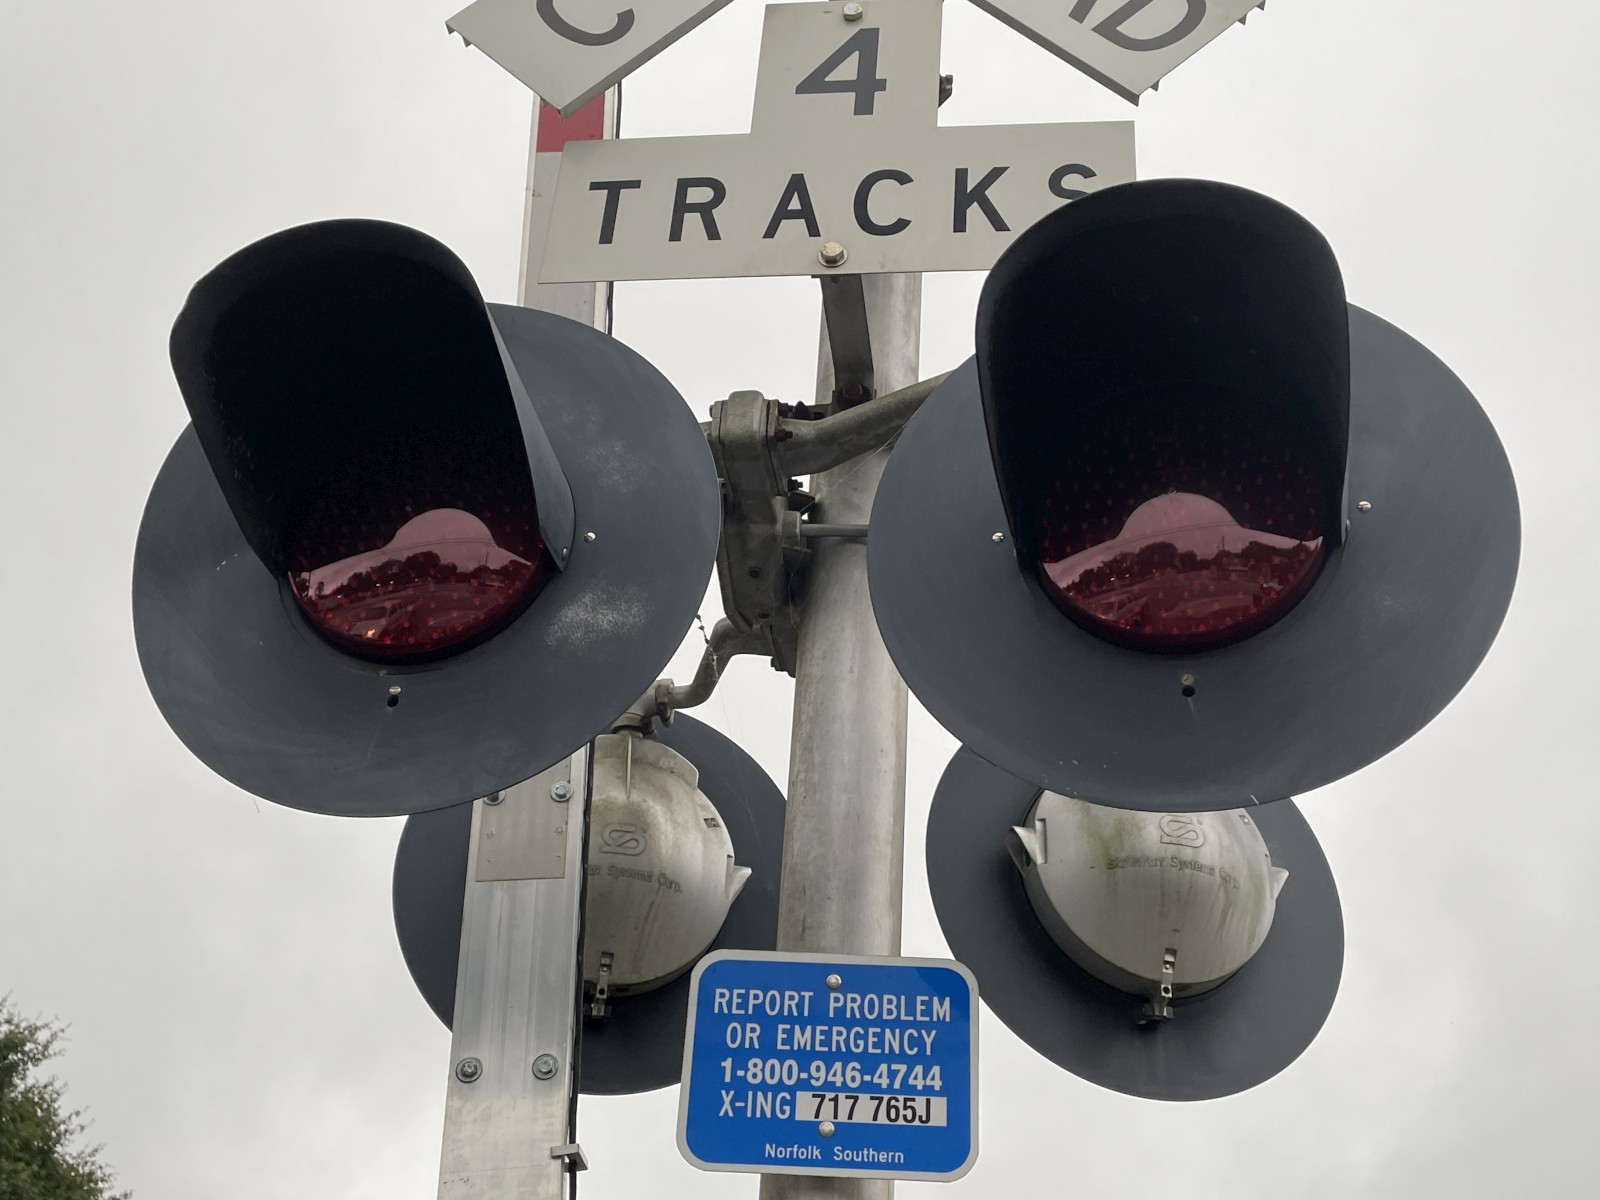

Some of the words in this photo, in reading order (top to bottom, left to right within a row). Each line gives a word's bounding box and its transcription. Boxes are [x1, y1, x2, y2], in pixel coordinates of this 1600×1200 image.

[794, 28, 887, 116] 4
[607, 864, 654, 883] Systems
[1169, 856, 1216, 877] Systems
[714, 988, 814, 1017] REPORT
[829, 993, 951, 1022] PROBLEM
[726, 1022, 761, 1049] OR
[776, 1024, 937, 1056] EMERGENCY
[720, 1057, 943, 1091] 1-800-946-4744
[719, 1090, 792, 1119] X-ING
[811, 1093, 860, 1121] 717
[869, 1096, 932, 1125] 765J
[765, 1143, 822, 1160] Norfolk
[833, 1146, 905, 1164] Southern
